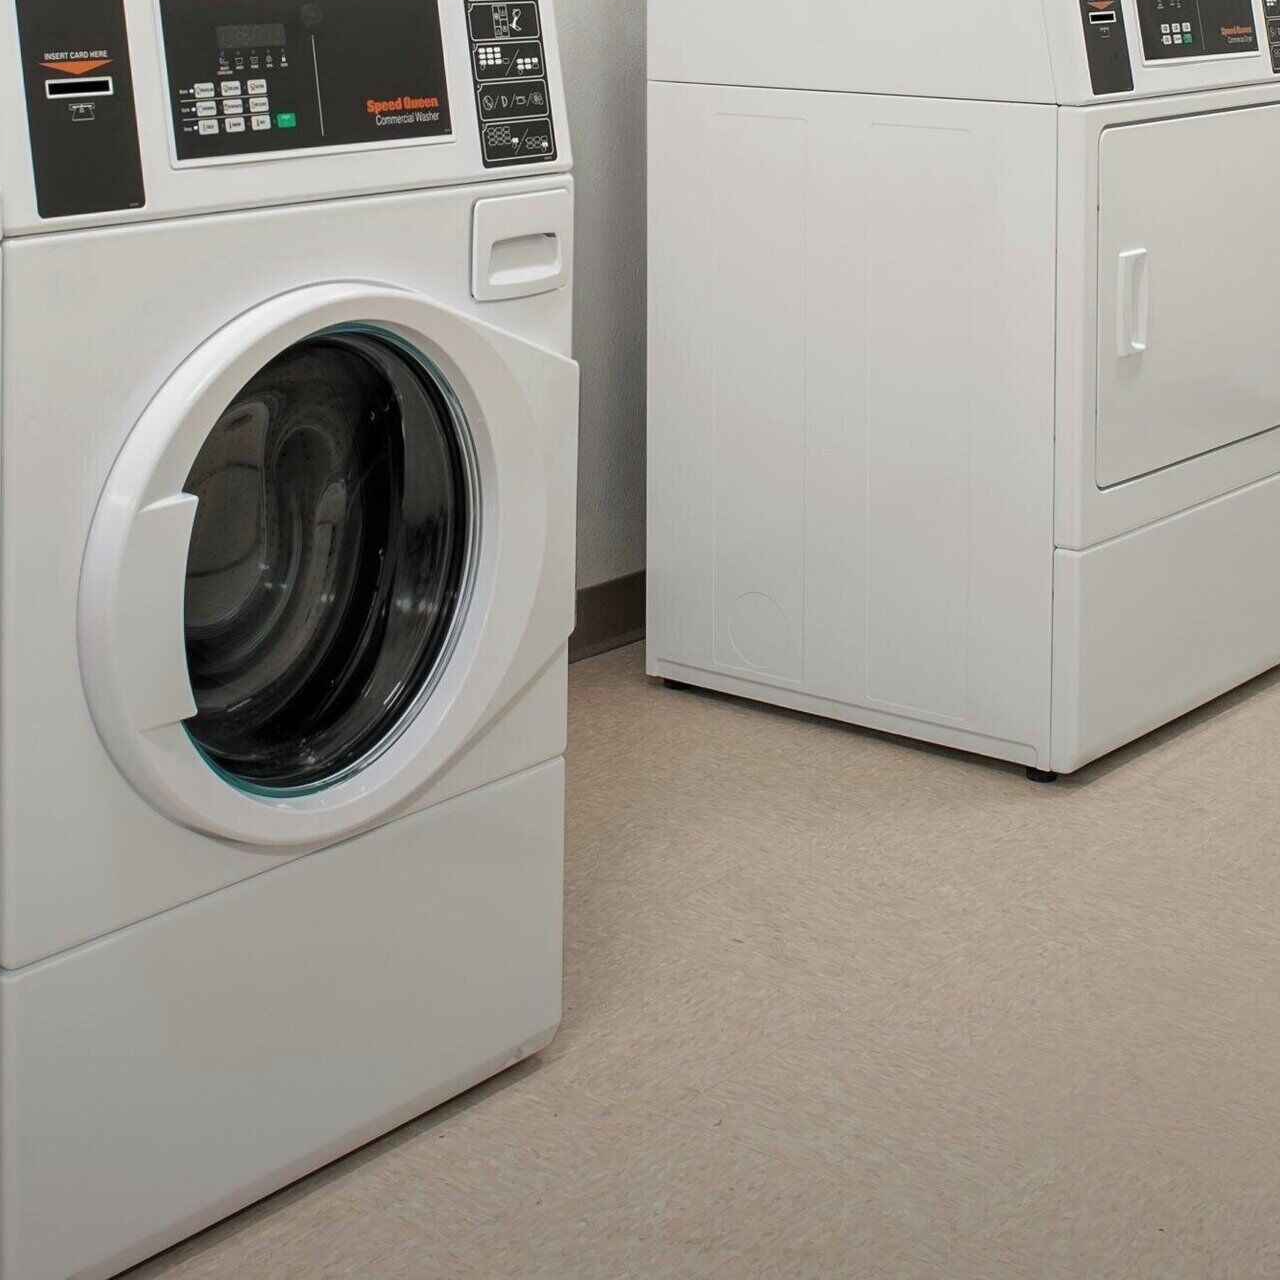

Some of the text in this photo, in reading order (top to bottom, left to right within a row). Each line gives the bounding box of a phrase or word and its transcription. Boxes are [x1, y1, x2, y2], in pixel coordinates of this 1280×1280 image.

[44, 50, 108, 60] INSERT CARD HERE
[366, 96, 439, 115] Speed Queen
[375, 111, 440, 126] Commercial Washer
